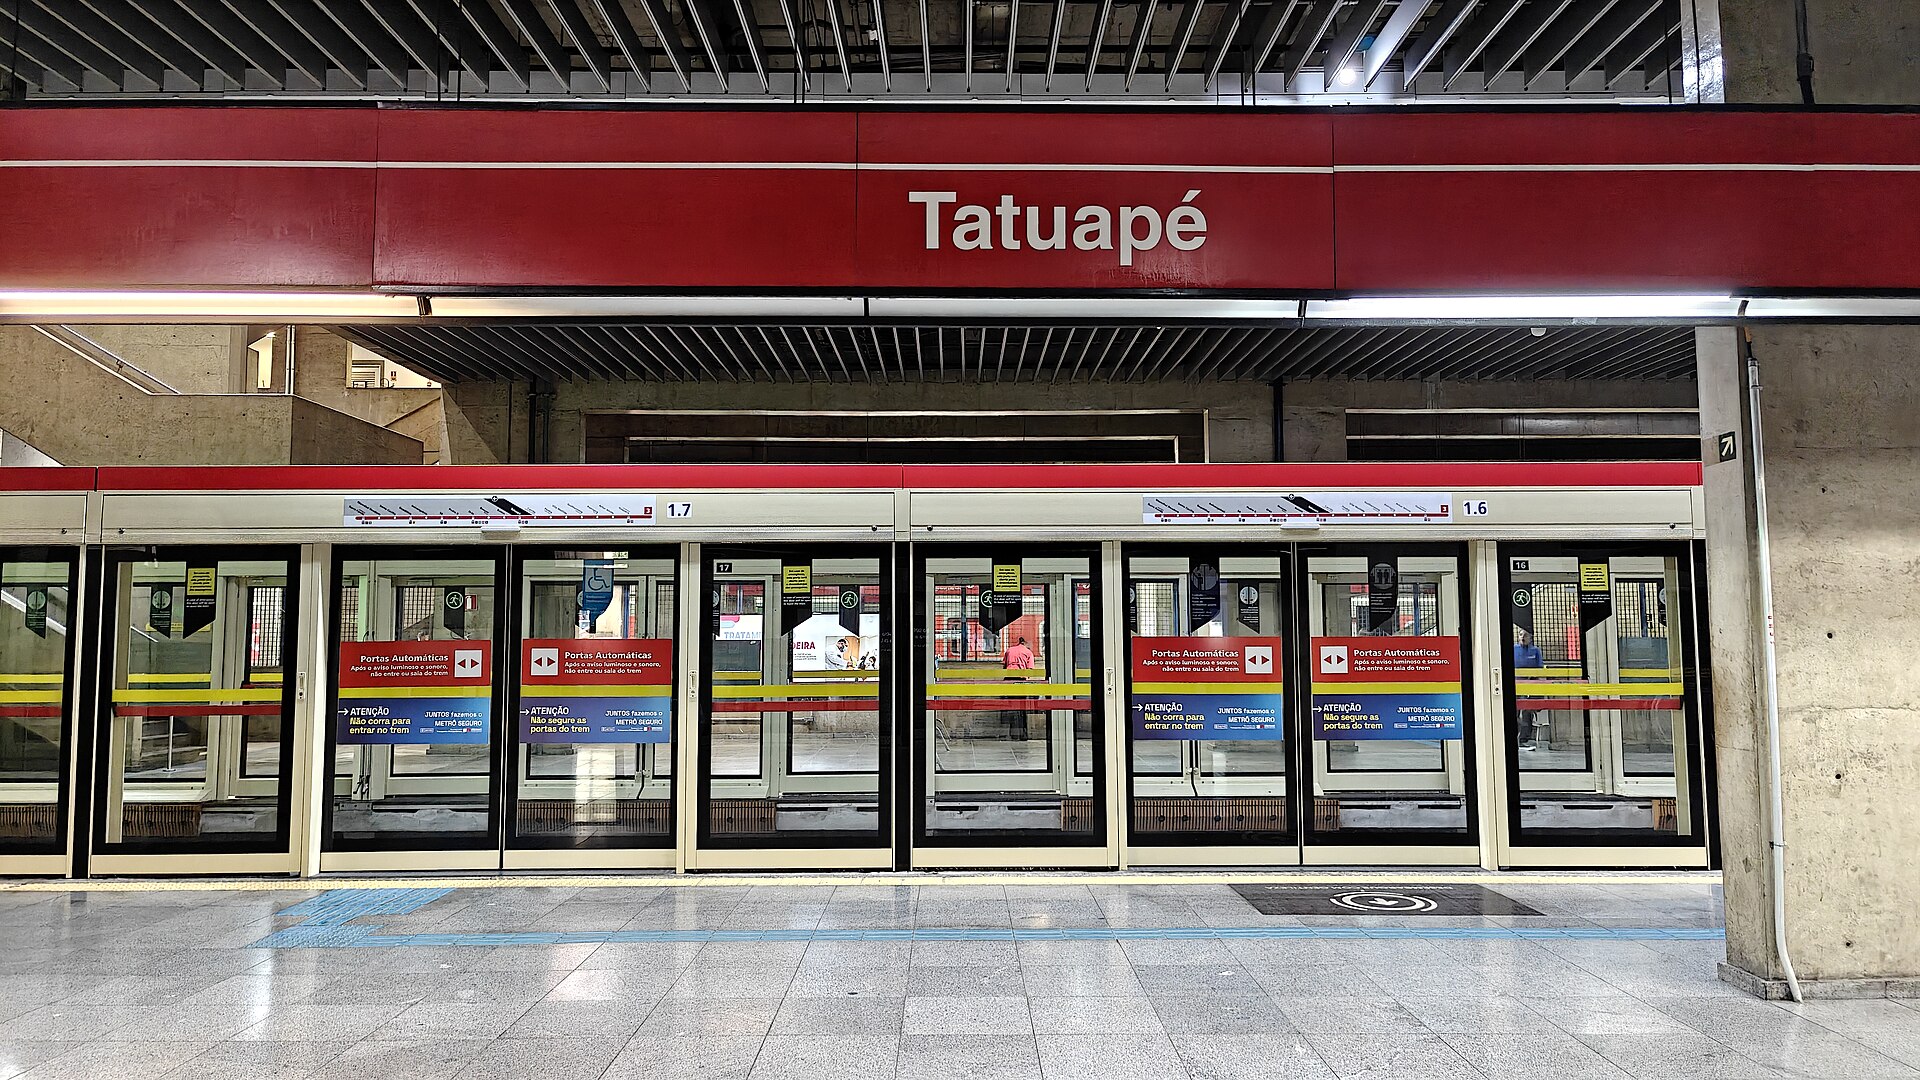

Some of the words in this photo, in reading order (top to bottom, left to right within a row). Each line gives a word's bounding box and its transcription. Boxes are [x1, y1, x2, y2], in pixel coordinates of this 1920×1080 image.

[908, 189, 1208, 266] Tatuapé
[668, 504, 691, 516] 1.7
[1464, 502, 1487, 514] 1.6
[392, 654, 448, 662] Automáticas
[350, 706, 389, 717] ATENÇÃO
[530, 706, 569, 716] ATENÇÃO
[1144, 702, 1182, 713] ATENÇÃO
[1323, 702, 1361, 714] ATENÇÃO
[392, 718, 410, 726] para
